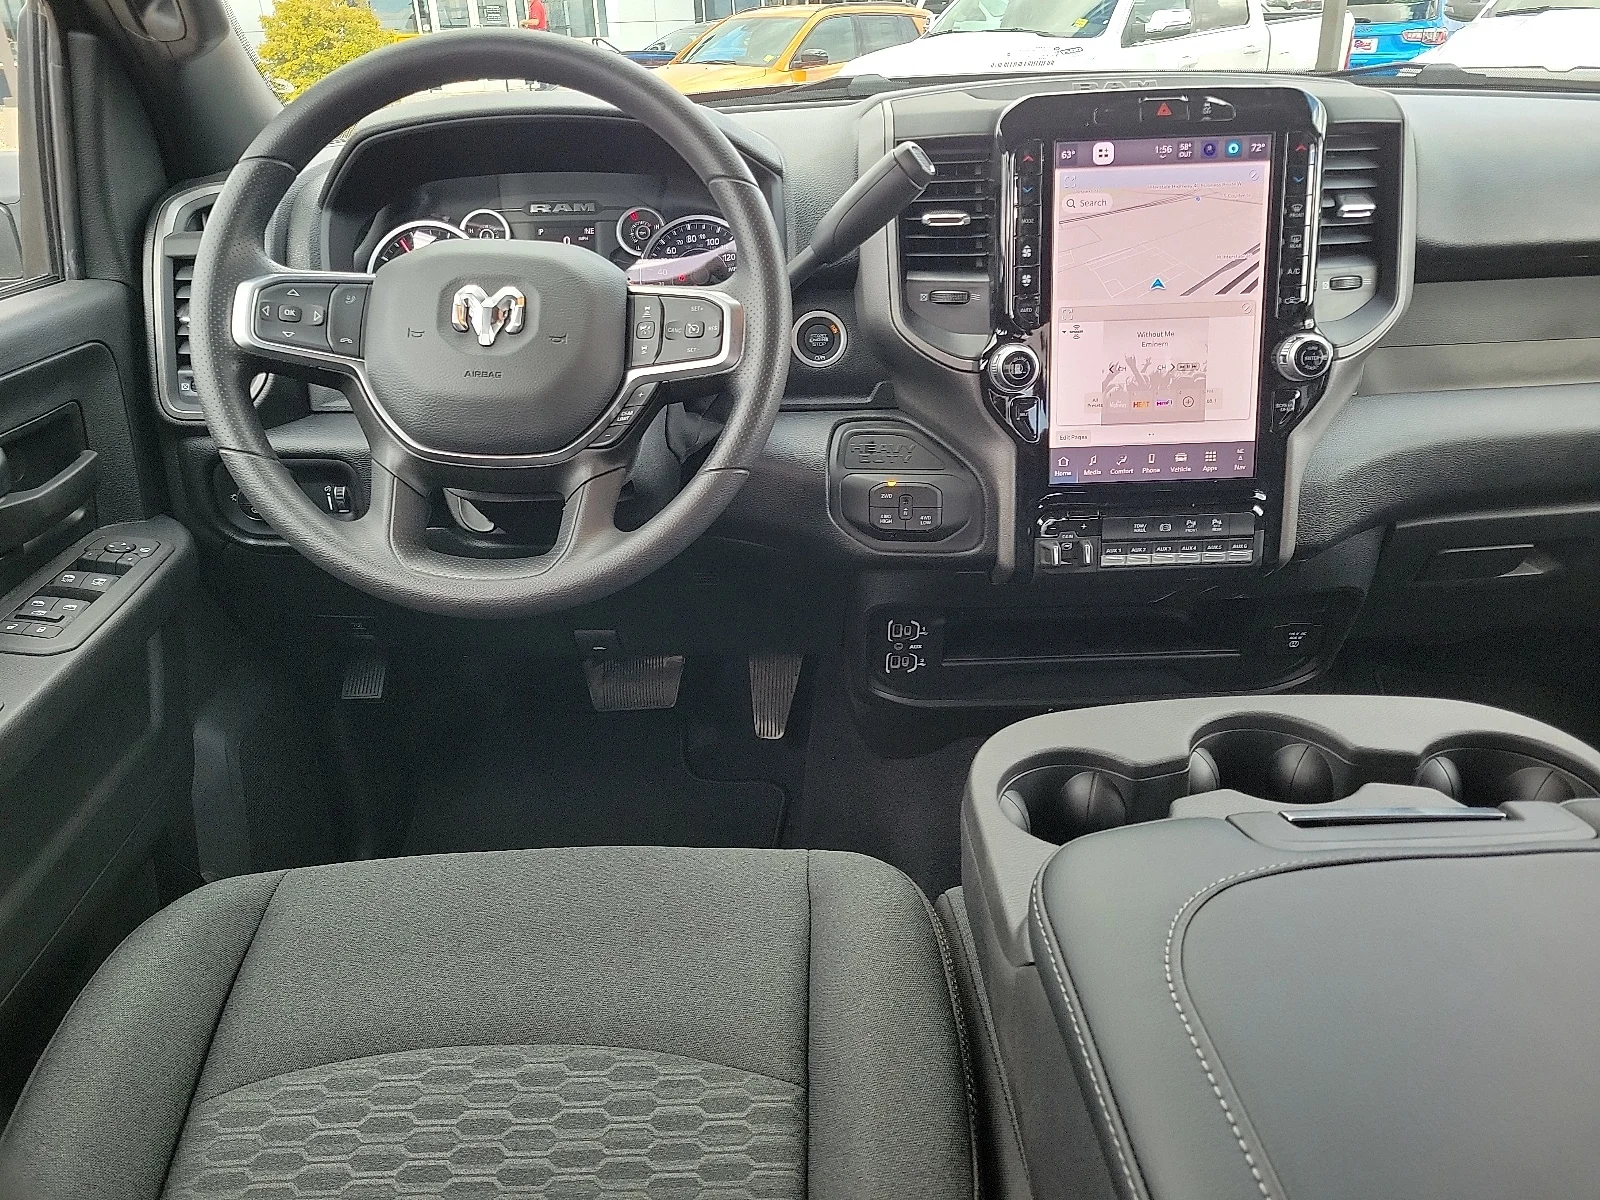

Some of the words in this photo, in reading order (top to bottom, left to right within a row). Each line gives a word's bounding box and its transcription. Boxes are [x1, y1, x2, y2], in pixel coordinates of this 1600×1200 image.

[1155, 145, 1173, 154] 1:56
[1250, 143, 1266, 153] 72°
[529, 202, 596, 213] RAM
[1079, 198, 1107, 208] Search
[538, 228, 544, 236] P
[583, 227, 595, 235] NE
[562, 236, 571, 245] 0
[685, 234, 697, 243] 80
[705, 237, 720, 246] 100
[665, 246, 677, 255] 60
[722, 253, 736, 262] 120
[657, 268, 668, 276] 40
[283, 308, 297, 317] OK
[463, 370, 502, 379] AIRBAG
[849, 442, 915, 454] HEAVY
[1202, 465, 1218, 473] Apps
